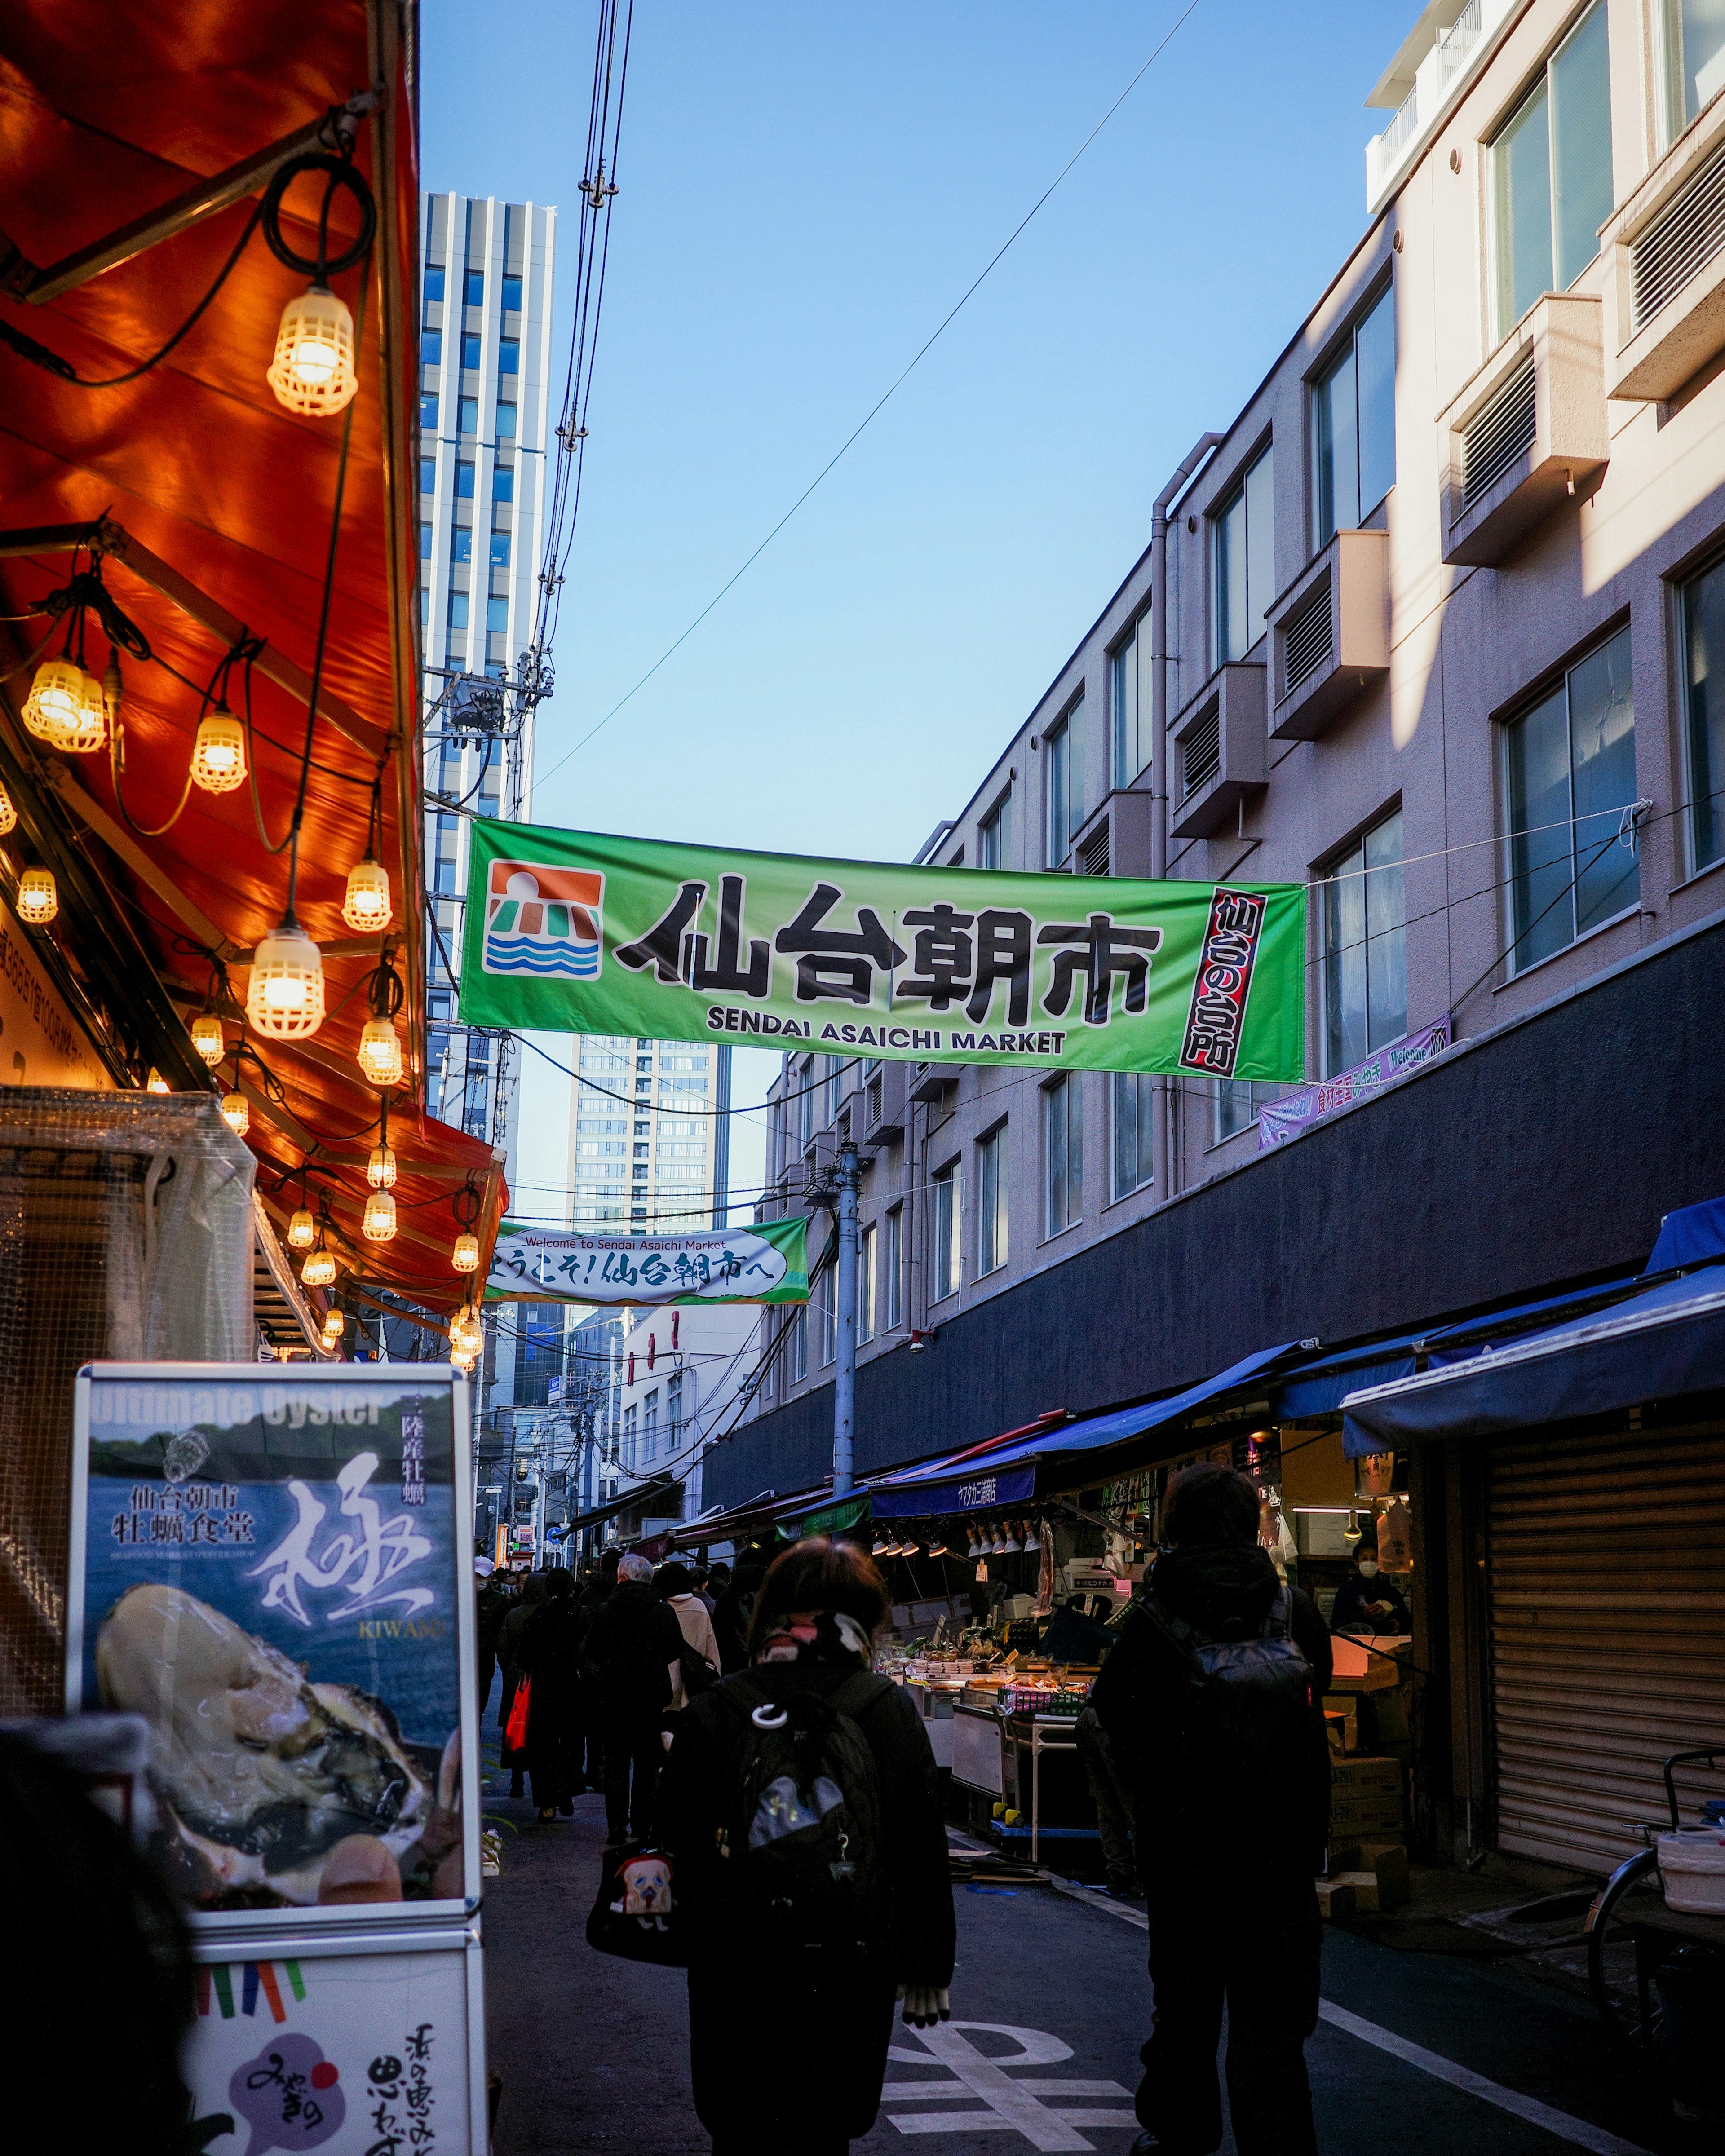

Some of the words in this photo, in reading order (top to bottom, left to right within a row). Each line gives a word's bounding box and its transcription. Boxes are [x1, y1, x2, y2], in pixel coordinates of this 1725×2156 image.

[614, 871, 1163, 1029] 仙台朝市
[1186, 894, 1259, 1070] 仙台の台所
[706, 1004, 811, 1039] SENDAI
[819, 1021, 942, 1051] ASAICHI
[950, 1029, 1066, 1056] MARKET
[1391, 1046, 1427, 1067] Welcome
[1318, 1062, 1382, 1116] 食材王国みやぎ
[526, 1236, 576, 1249] Welcome
[580, 1240, 594, 1249] to
[597, 1240, 636, 1250] Sendai
[640, 1240, 681, 1250] Asaichi
[686, 1240, 726, 1250] Market
[90, 1385, 253, 1425] Ultimate
[263, 1387, 381, 1429] Oyster
[401, 1394, 426, 1506] 三陸産牡蠣
[130, 1485, 238, 1512] 仙台朝市
[958, 1478, 996, 1507] ヤマタカ三浦商店
[111, 1512, 256, 1545] 牡蠣食堂
[358, 1620, 445, 1639] KIWAMI
